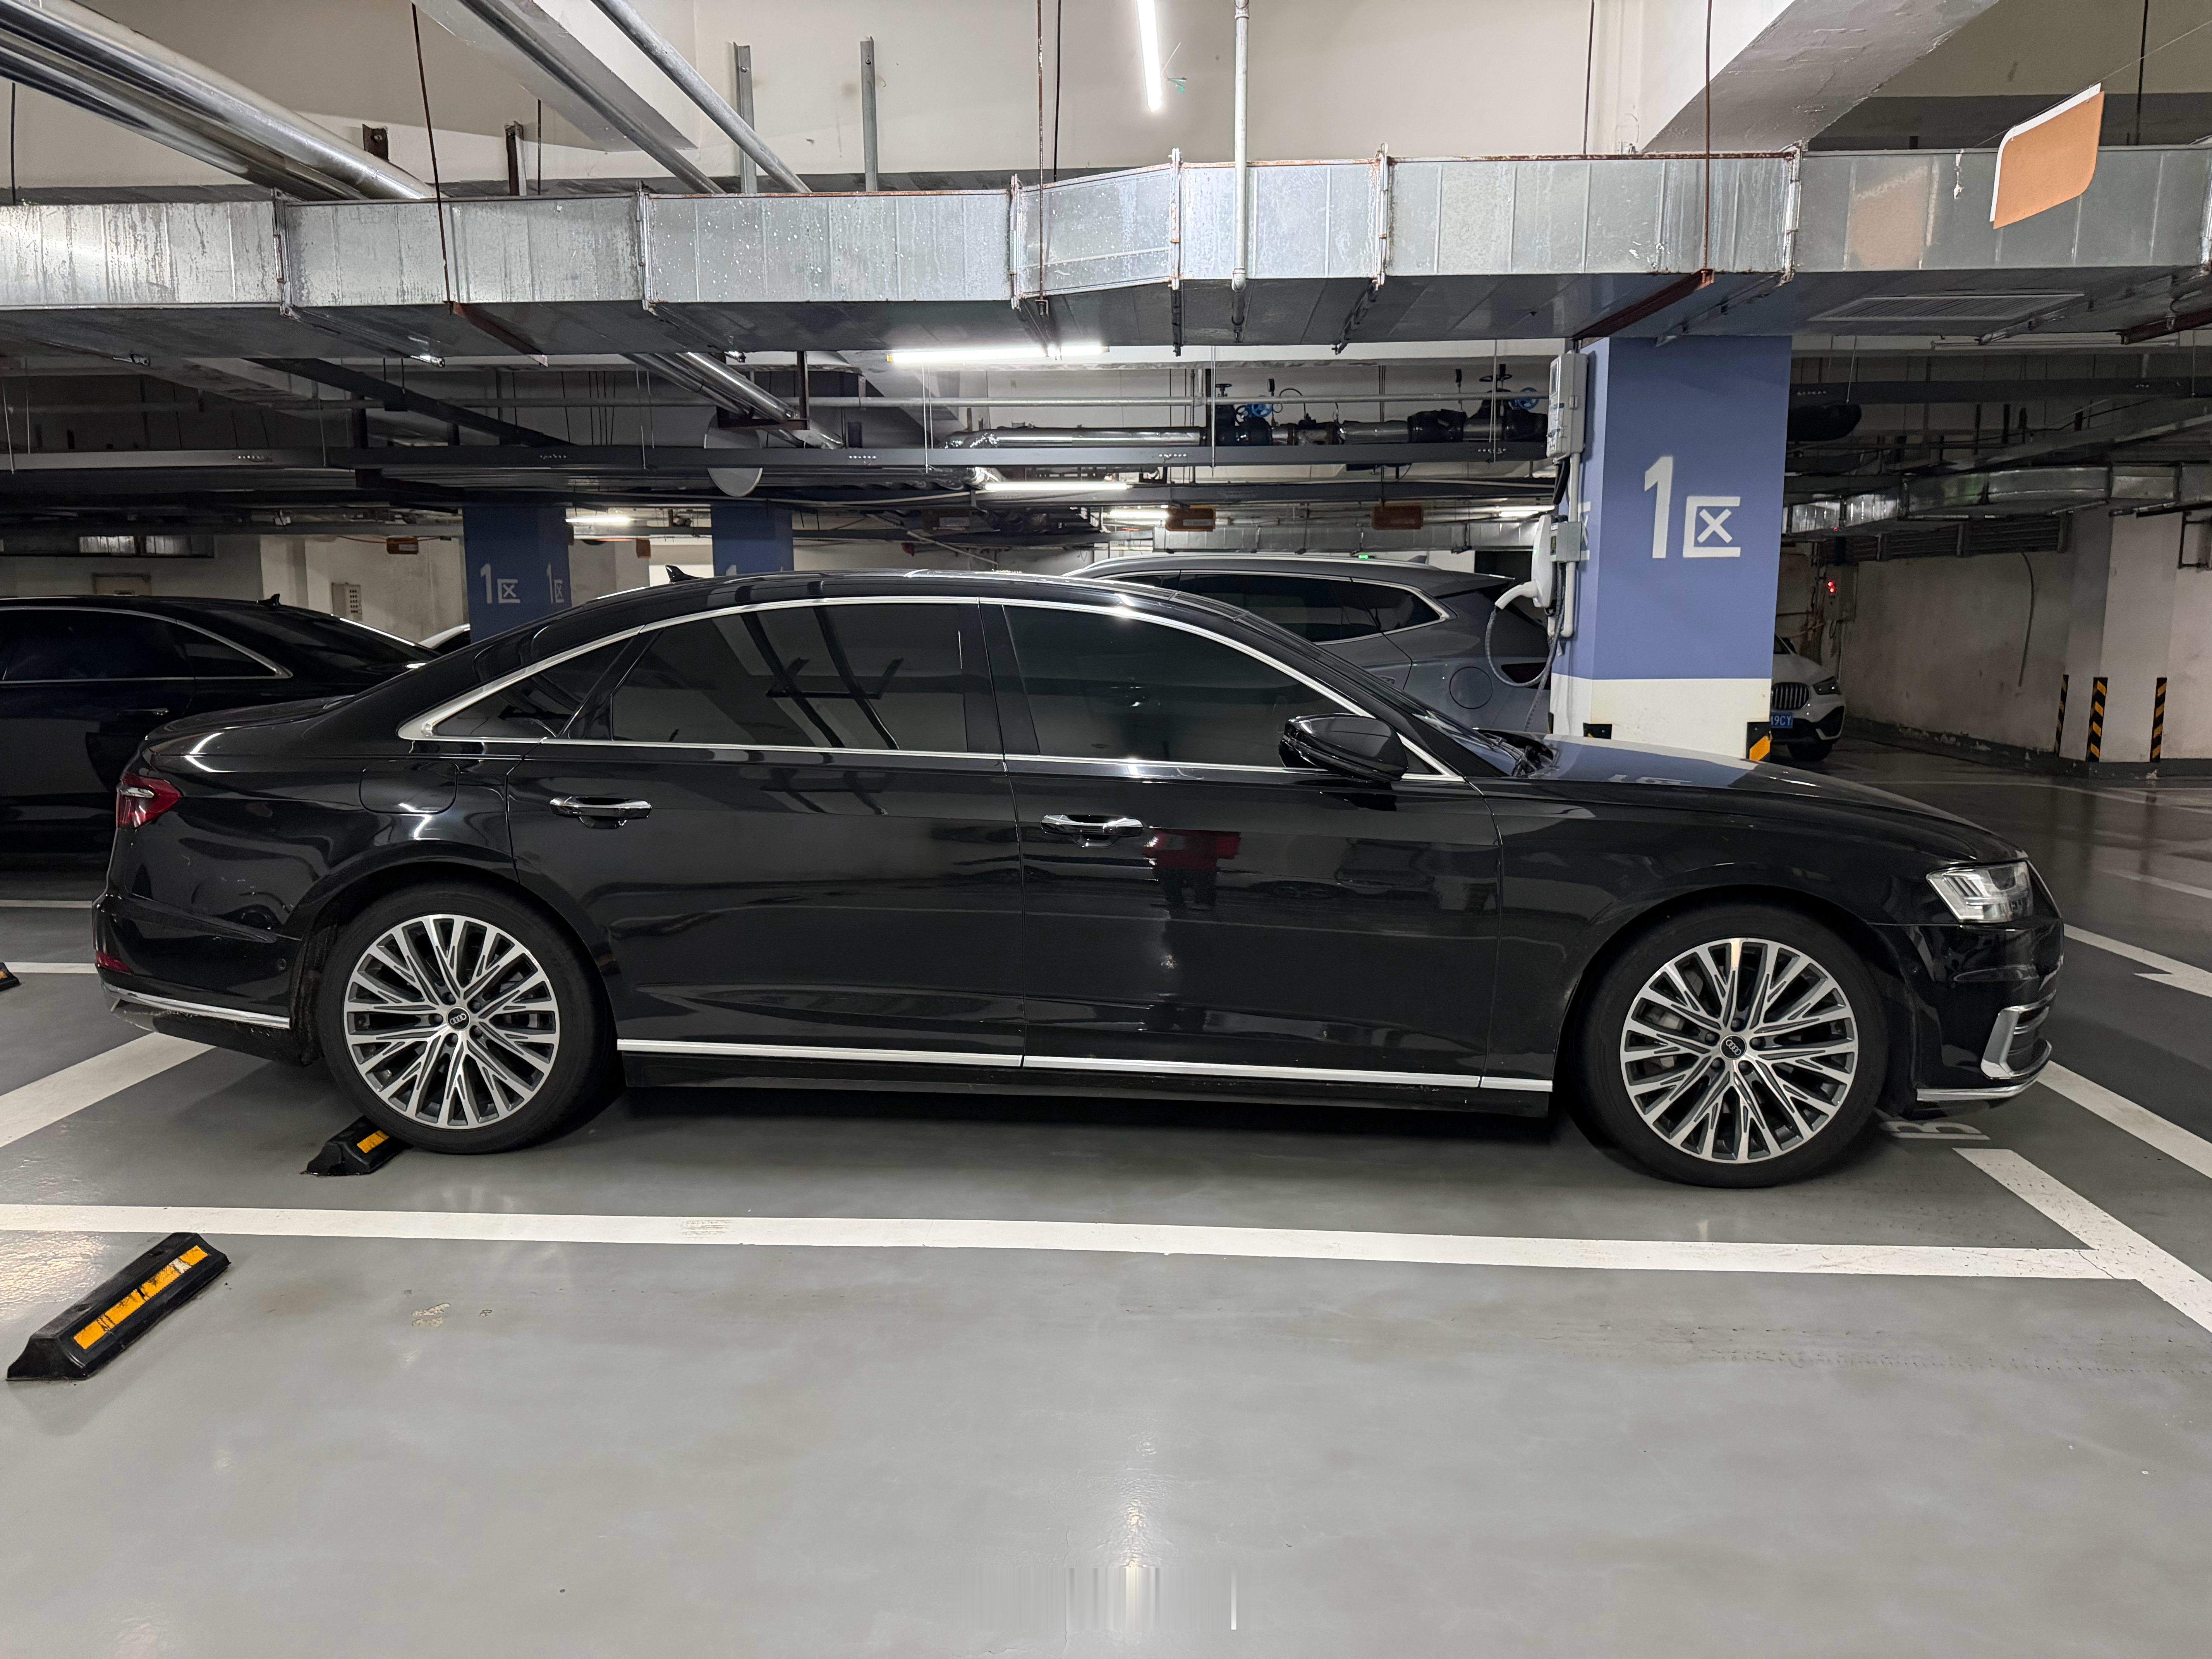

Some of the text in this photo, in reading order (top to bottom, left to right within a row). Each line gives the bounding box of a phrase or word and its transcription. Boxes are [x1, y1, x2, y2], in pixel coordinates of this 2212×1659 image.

[1644, 456, 1741, 558] 1区
[480, 563, 520, 604] 1区
[546, 563, 565, 604] 1区
